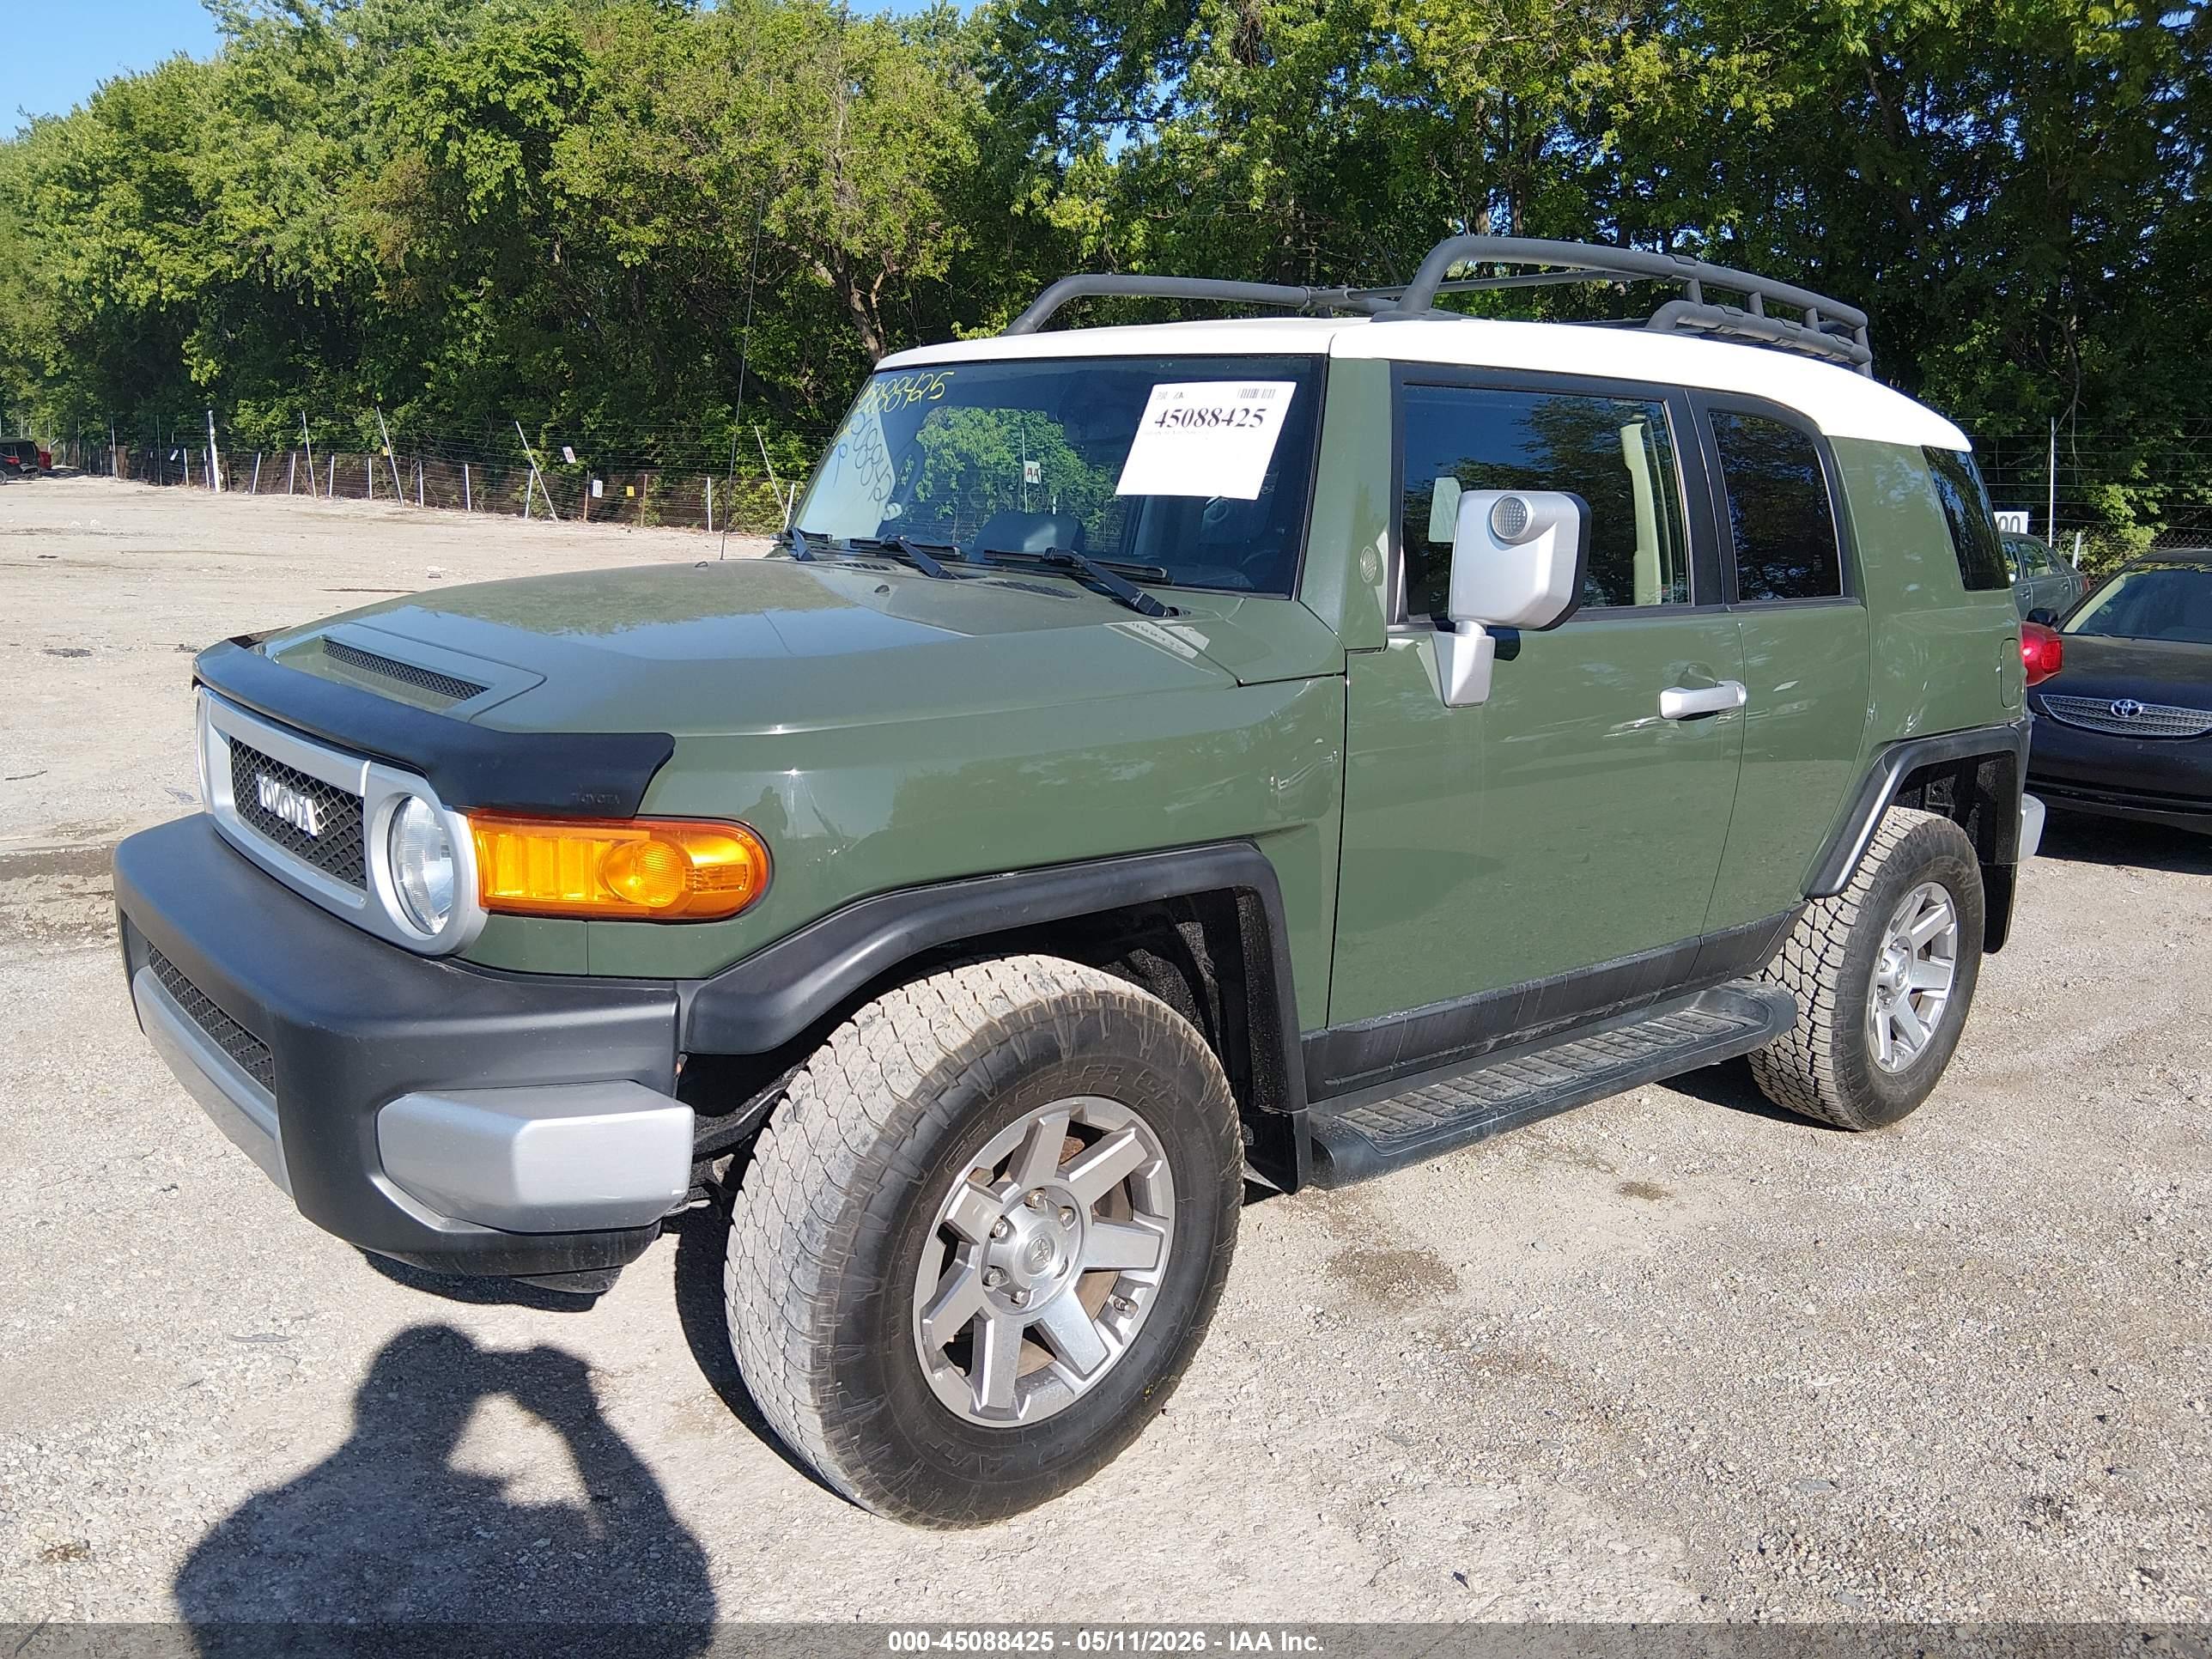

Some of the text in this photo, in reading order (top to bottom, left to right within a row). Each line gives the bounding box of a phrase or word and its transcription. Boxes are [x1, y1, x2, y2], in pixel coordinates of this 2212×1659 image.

[1154, 407, 1267, 428] 45088425
[255, 773, 319, 836] TOYOTA
[570, 792, 621, 805] TOYOTA
